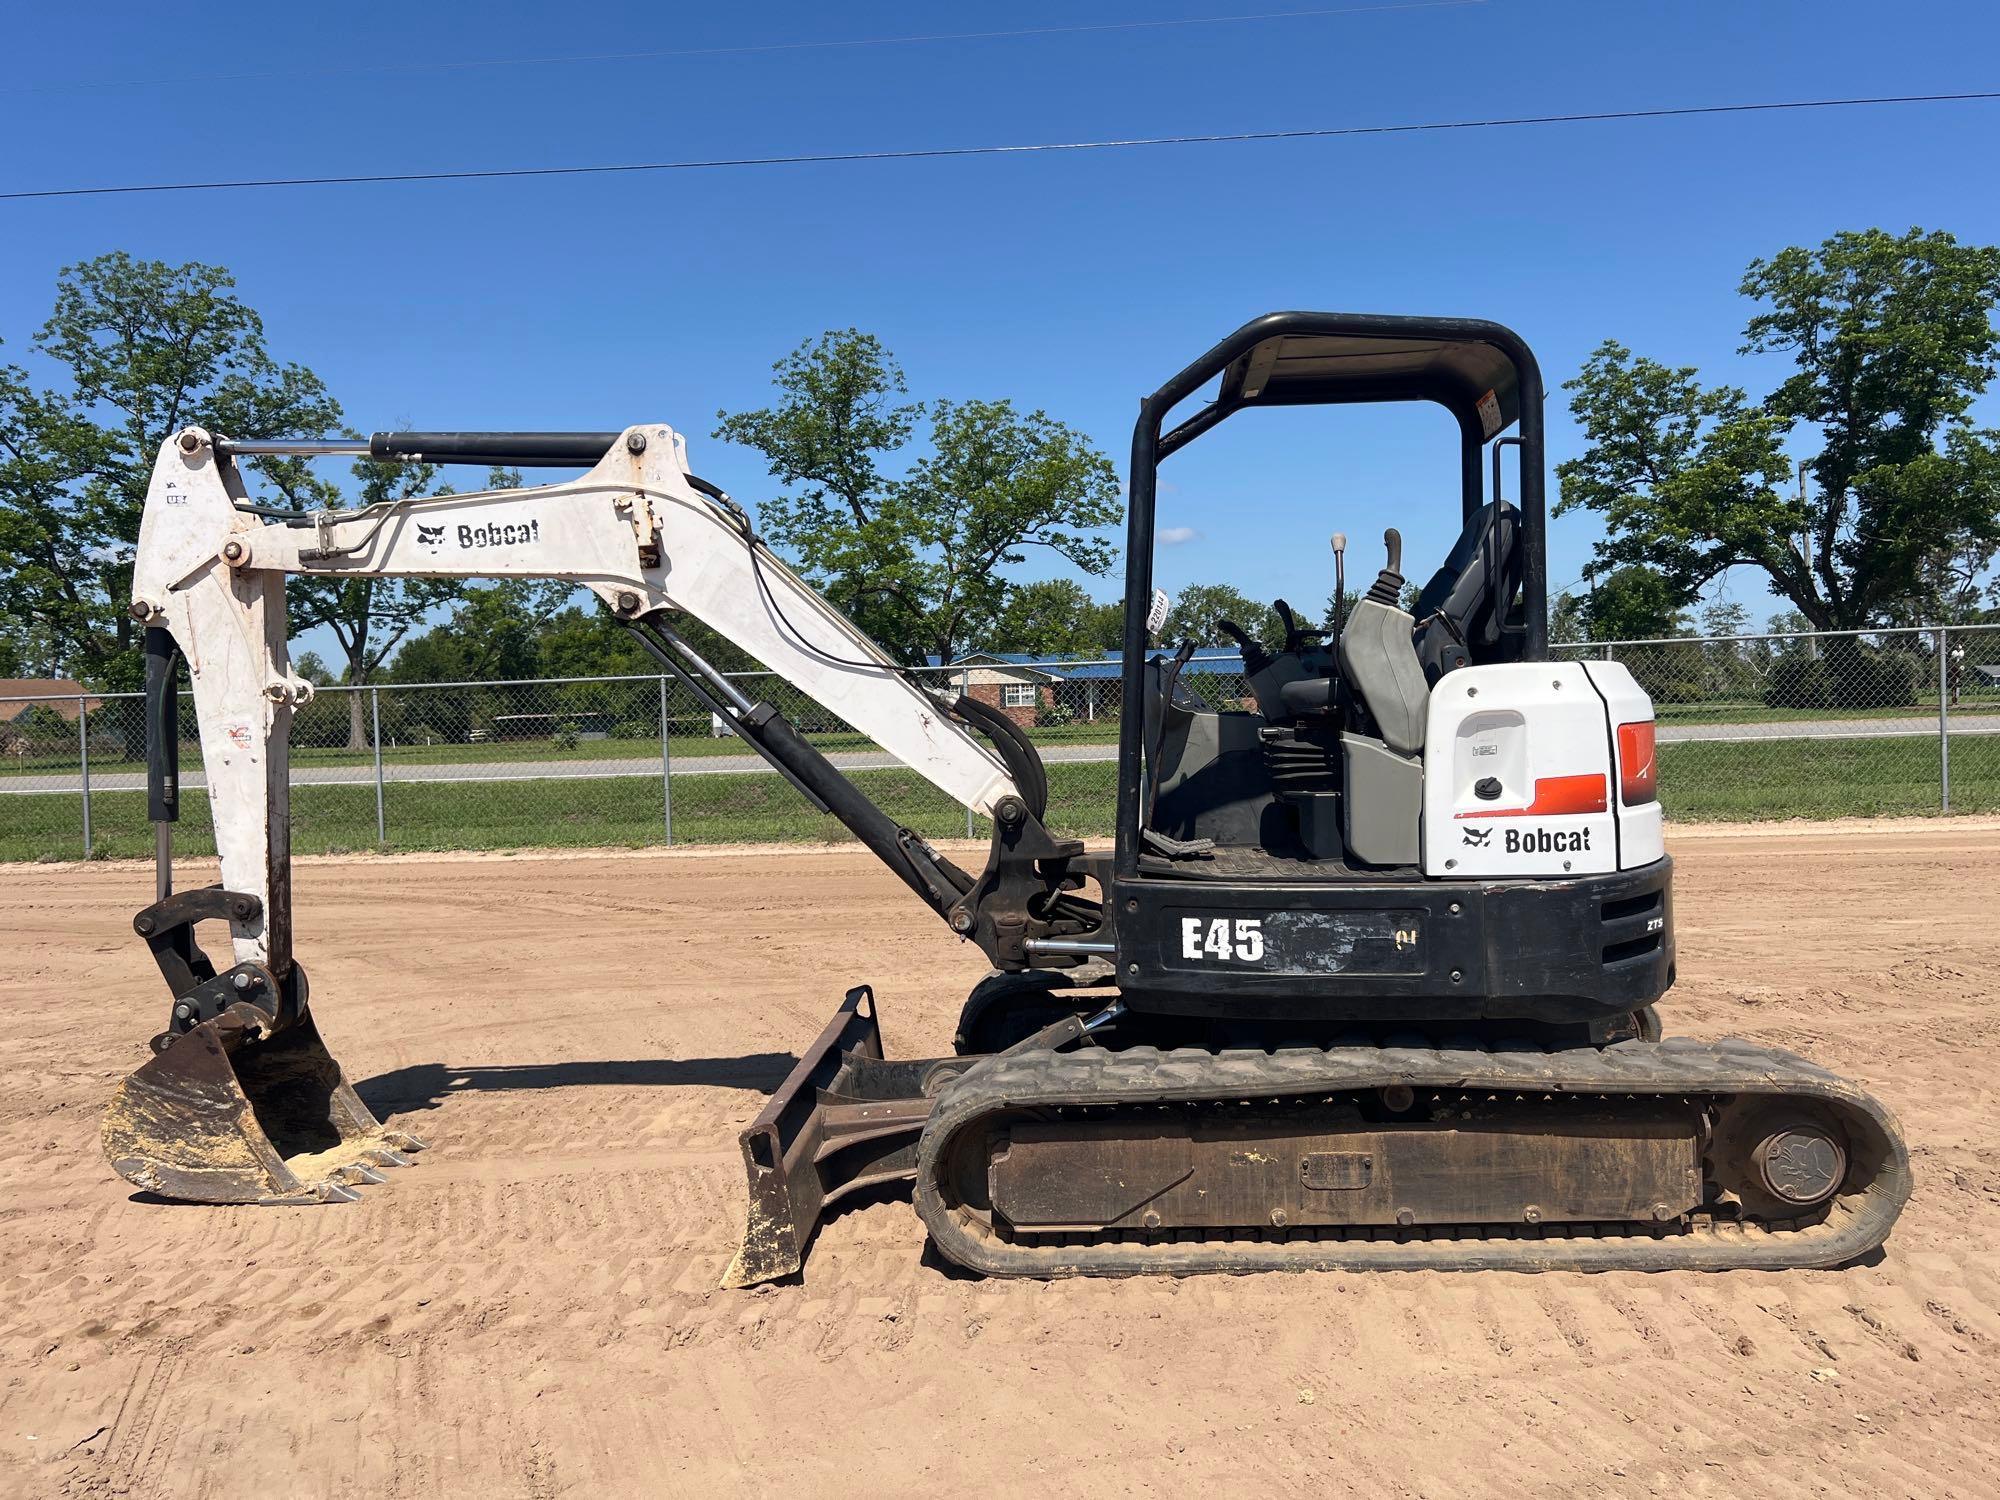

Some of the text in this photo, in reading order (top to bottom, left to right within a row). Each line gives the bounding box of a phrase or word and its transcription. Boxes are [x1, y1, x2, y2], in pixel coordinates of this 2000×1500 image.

[457, 519, 538, 549] Bobcat
[1505, 827, 1591, 853] Bobcat
[1646, 917, 1664, 931] ZTS
[1181, 917, 1264, 961] E45
